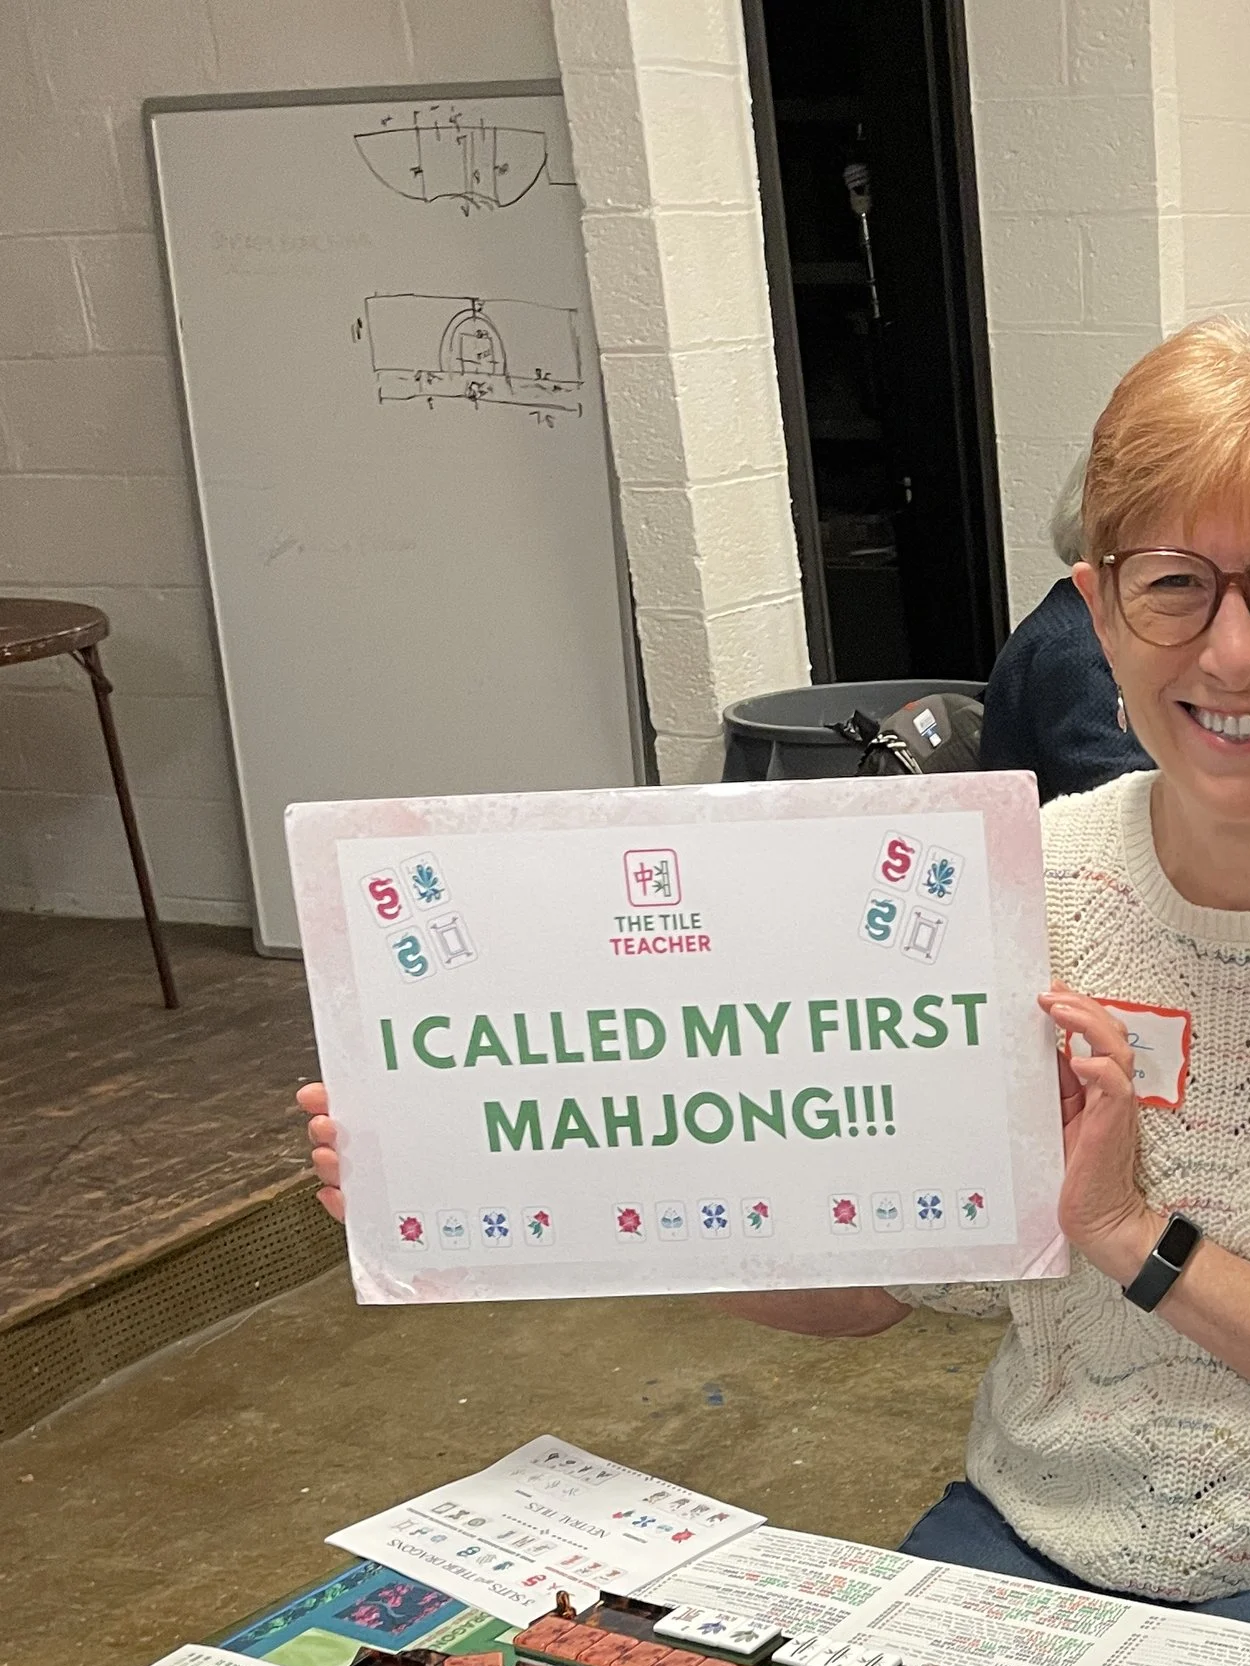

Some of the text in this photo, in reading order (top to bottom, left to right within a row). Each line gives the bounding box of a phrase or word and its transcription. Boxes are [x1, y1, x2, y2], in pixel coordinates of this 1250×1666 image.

[615, 913, 701, 932] THE TILE
[610, 935, 711, 955] TEACHER
[380, 993, 988, 1071] I CALLED MY FIRST
[484, 1085, 897, 1152] MAHJONG!!!
[558, 1509, 610, 1538] NEUTRAL
[387, 1539, 449, 1568] DRAGONS
[491, 1582, 527, 1604] SUITS
